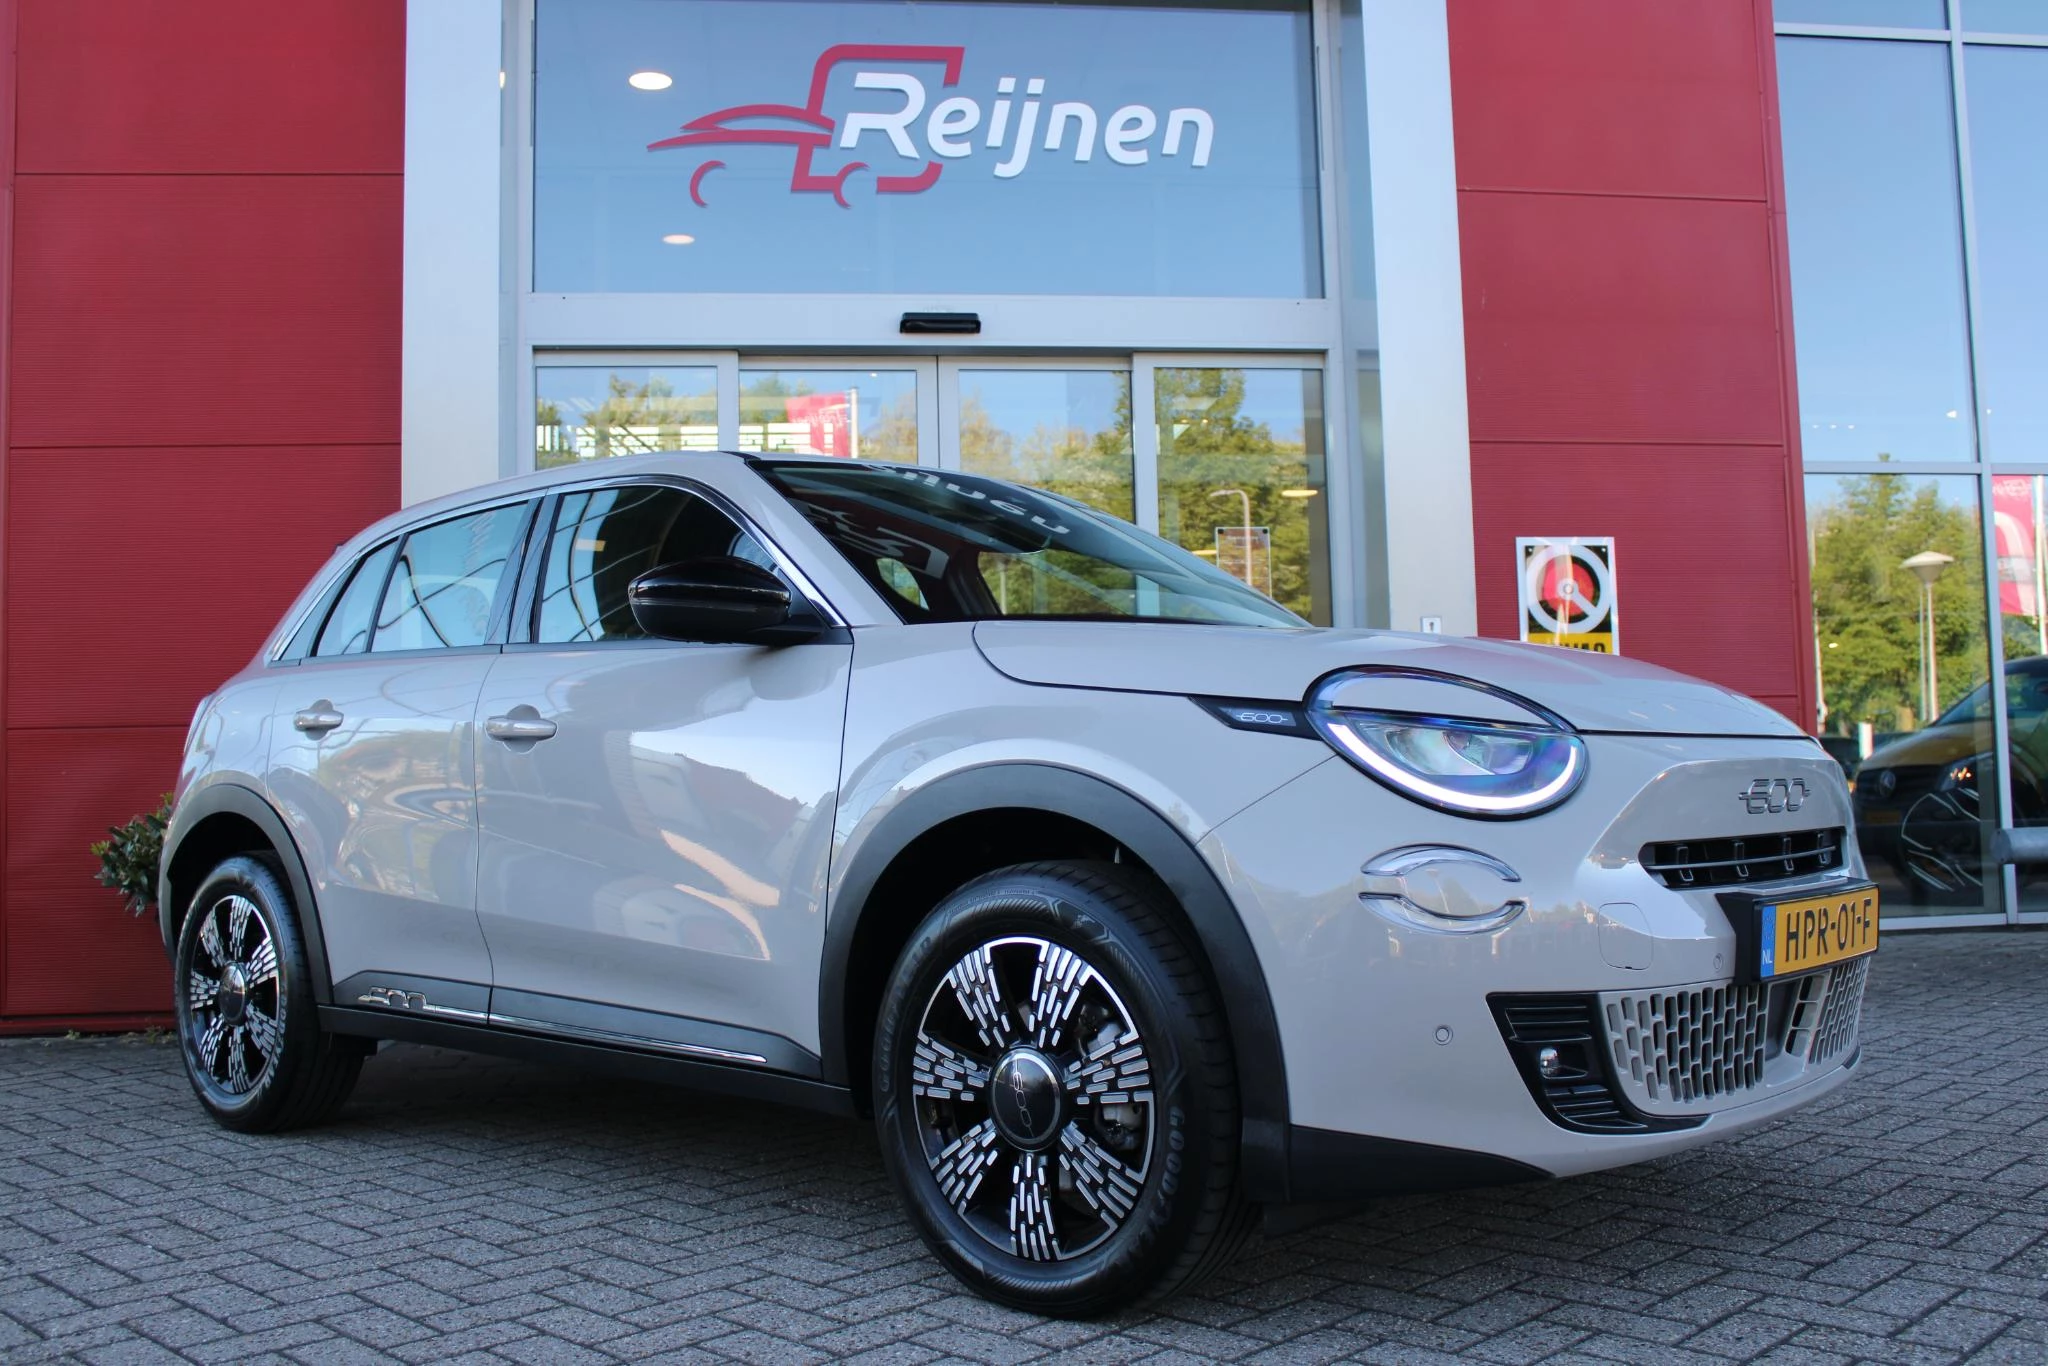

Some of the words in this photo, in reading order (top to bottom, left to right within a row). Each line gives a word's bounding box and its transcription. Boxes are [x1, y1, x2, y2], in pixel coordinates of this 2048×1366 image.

[839, 71, 1215, 178] Reijnen
[1239, 712, 1284, 724] 600
[1745, 778, 1806, 813] 600
[1762, 949, 1773, 965] NL
[1785, 898, 1872, 962] HPR-01-F
